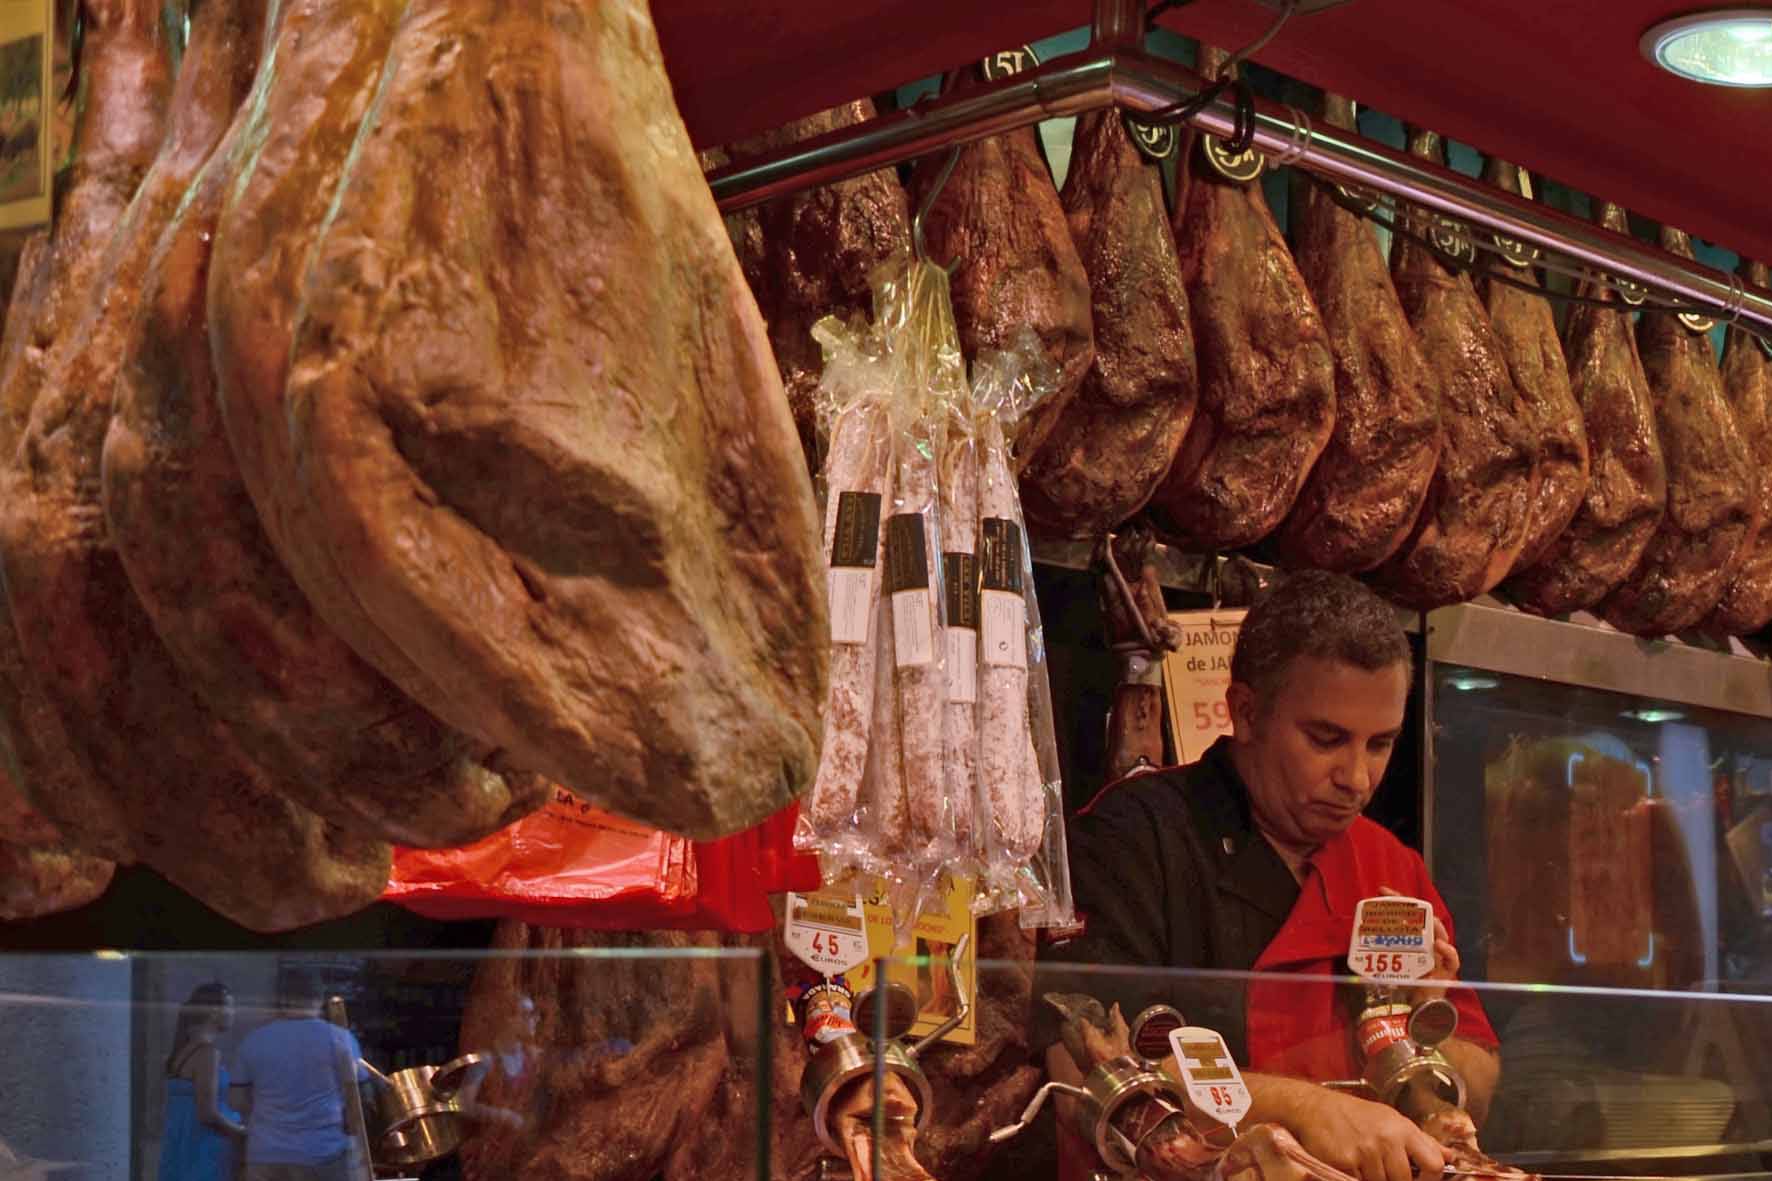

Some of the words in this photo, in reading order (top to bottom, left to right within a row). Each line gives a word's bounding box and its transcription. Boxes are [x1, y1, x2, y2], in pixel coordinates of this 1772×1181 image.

[1186, 656, 1206, 672] de
[1210, 656, 1233, 672] JA
[812, 931, 840, 956] 45
[1364, 953, 1403, 973] 155
